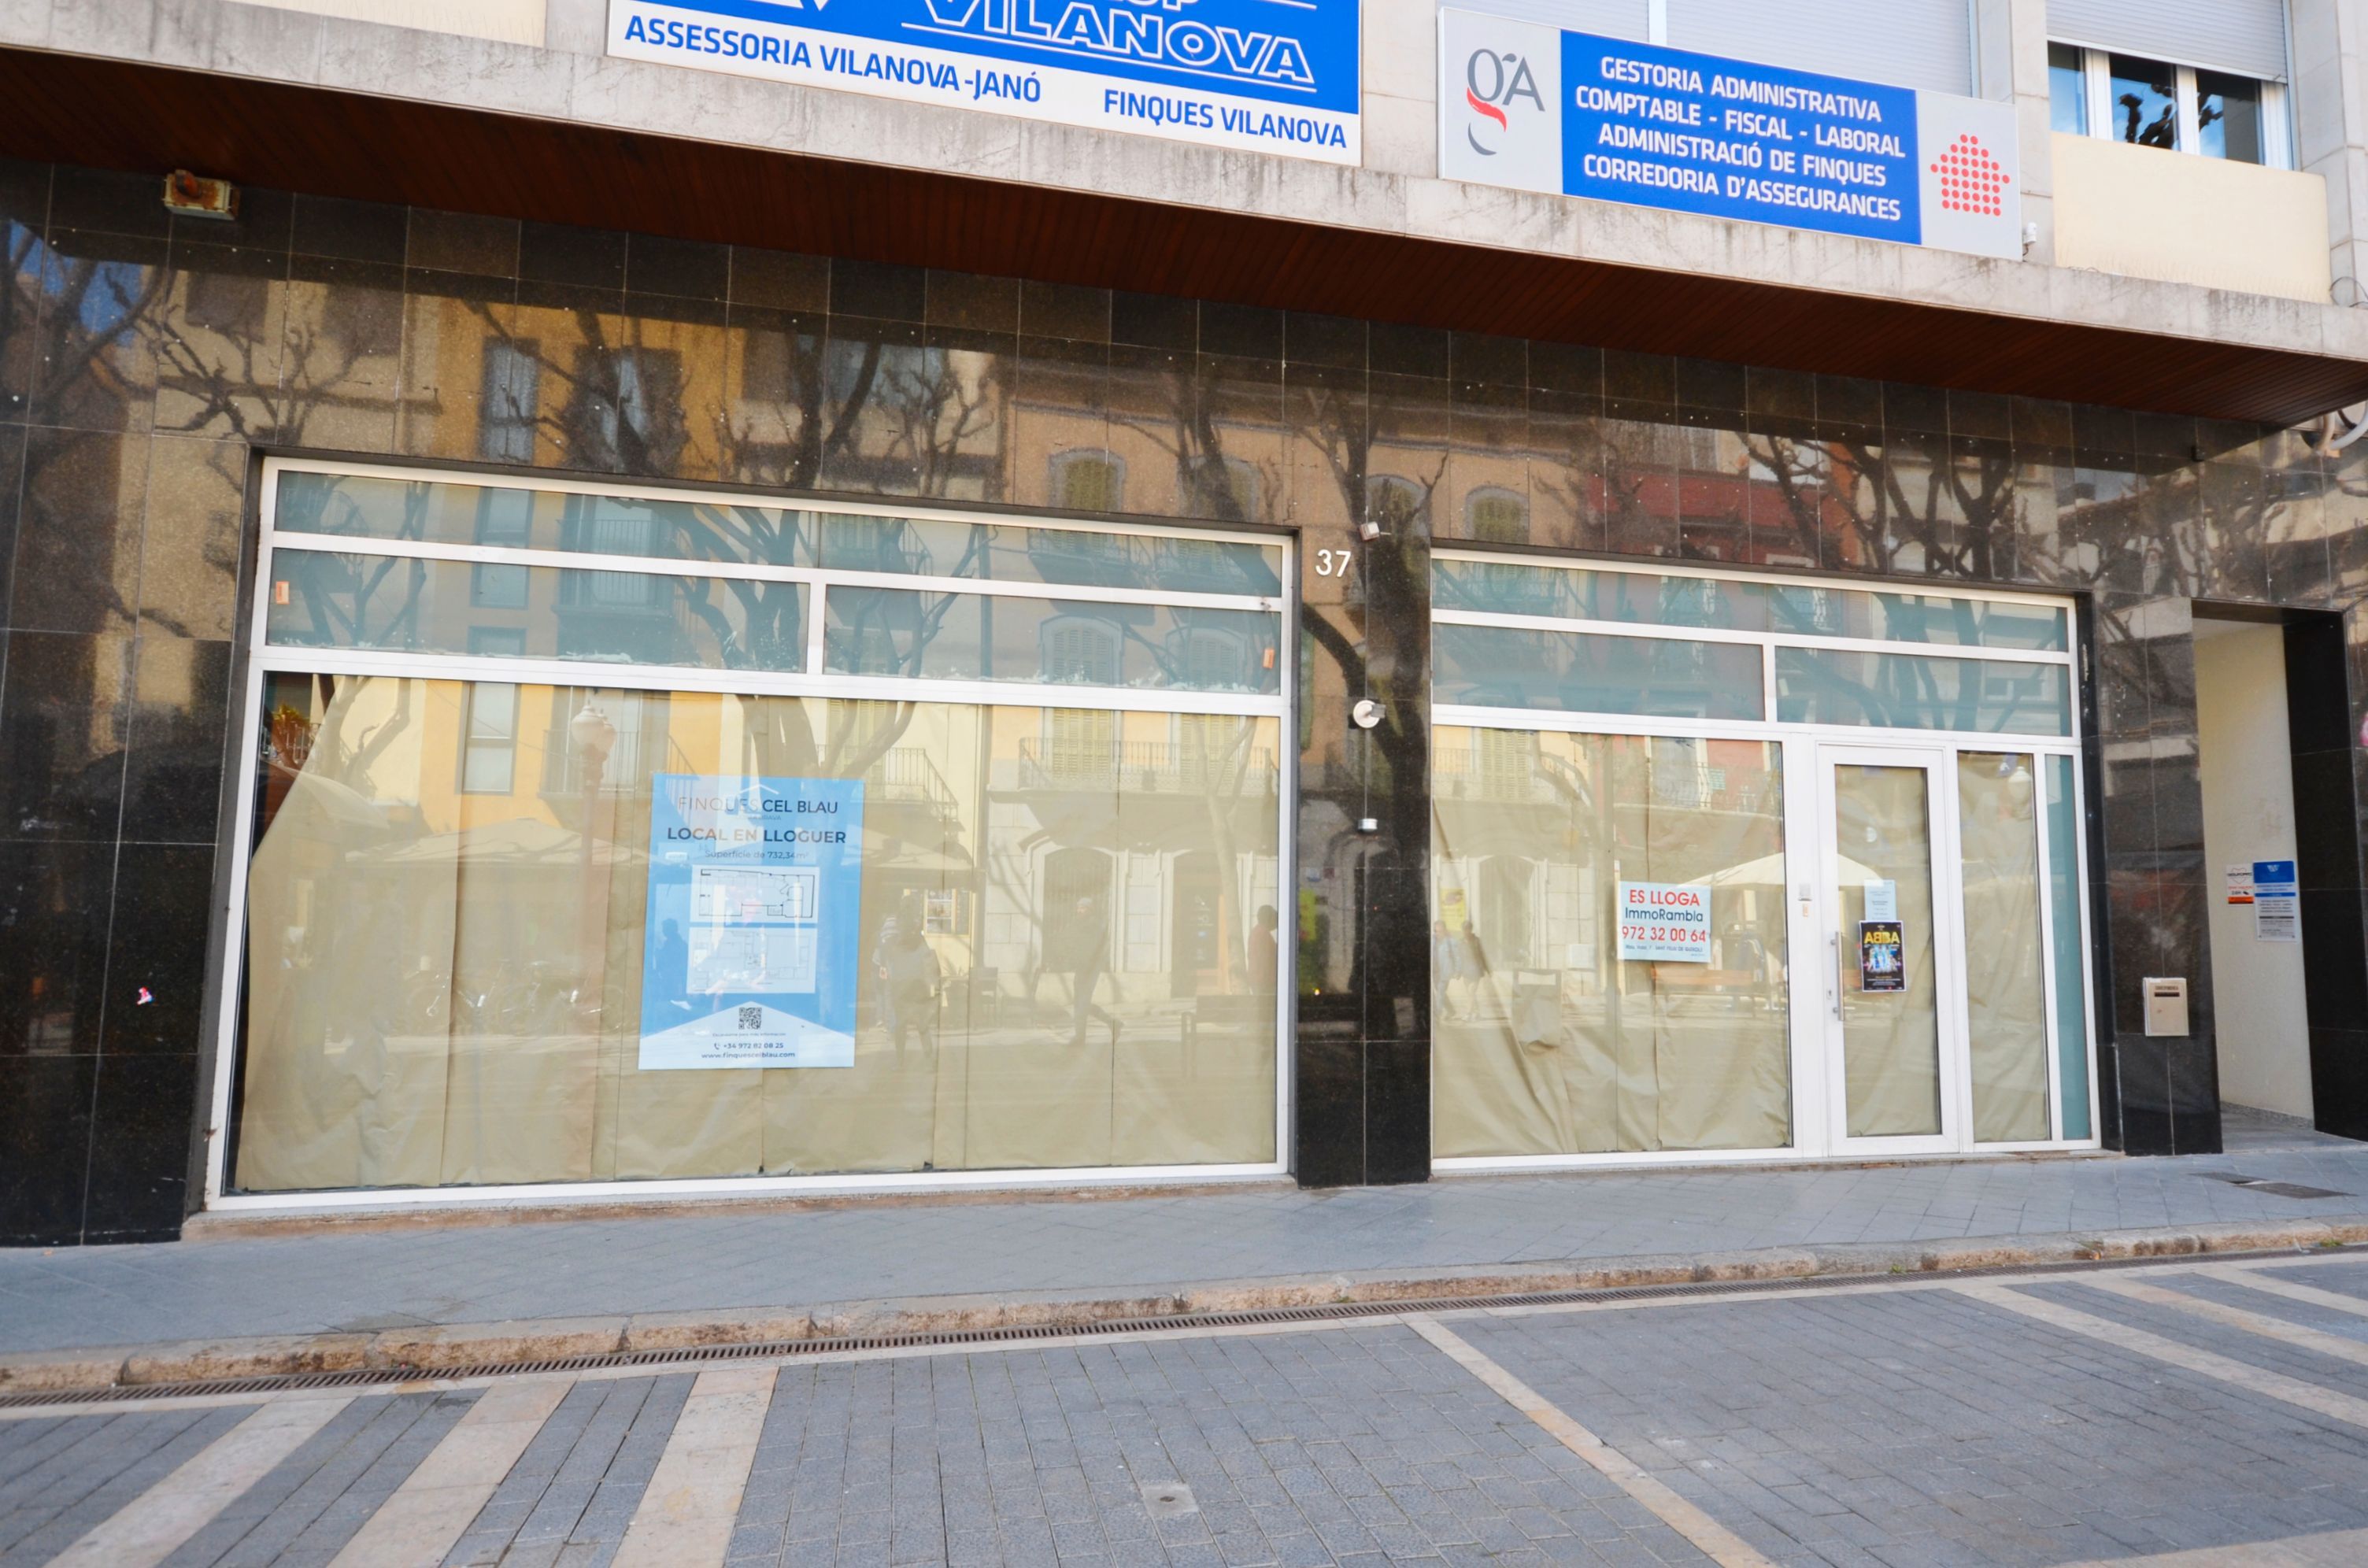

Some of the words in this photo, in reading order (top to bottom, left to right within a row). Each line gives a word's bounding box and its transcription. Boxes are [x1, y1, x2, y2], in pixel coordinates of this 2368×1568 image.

[624, 15, 812, 68] ASSESSORIA
[924, 0, 1315, 84] VILANOVA
[1601, 56, 1704, 94] GESTORIA
[1711, 75, 1882, 122] ADMINISTRATIVA
[1104, 89, 1214, 128] FINQUES
[1220, 106, 1347, 148] VILANOVA
[1576, 85, 1701, 126] COMPTABLE
[1725, 109, 1793, 140] FISCAL
[1815, 124, 1906, 157] LABORAL
[1598, 123, 1763, 168] ADMINISTRACIÓ
[1770, 149, 1796, 173] DE
[1803, 154, 1886, 187] FINQUES
[1584, 153, 1719, 195] CORREDORIA
[1726, 176, 1901, 221] D'ASSEGURANCES
[1315, 549, 1352, 578] 37
[678, 797, 758, 812] FINQUES
[762, 799, 793, 812] CEL
[797, 800, 838, 814] BLAU
[667, 827, 727, 841] LOCAL
[734, 829, 757, 841] EN
[764, 830, 846, 844] LLOGUER
[1625, 907, 1704, 922] ImmoRambla
[1629, 889, 1645, 904] ES
[1650, 890, 1700, 907] LLOGA
[1622, 926, 1645, 941] 972
[1650, 926, 1666, 941] 32
[1670, 927, 1686, 942] 00
[1690, 929, 1707, 943] 64
[1863, 931, 1900, 944] ABBA
